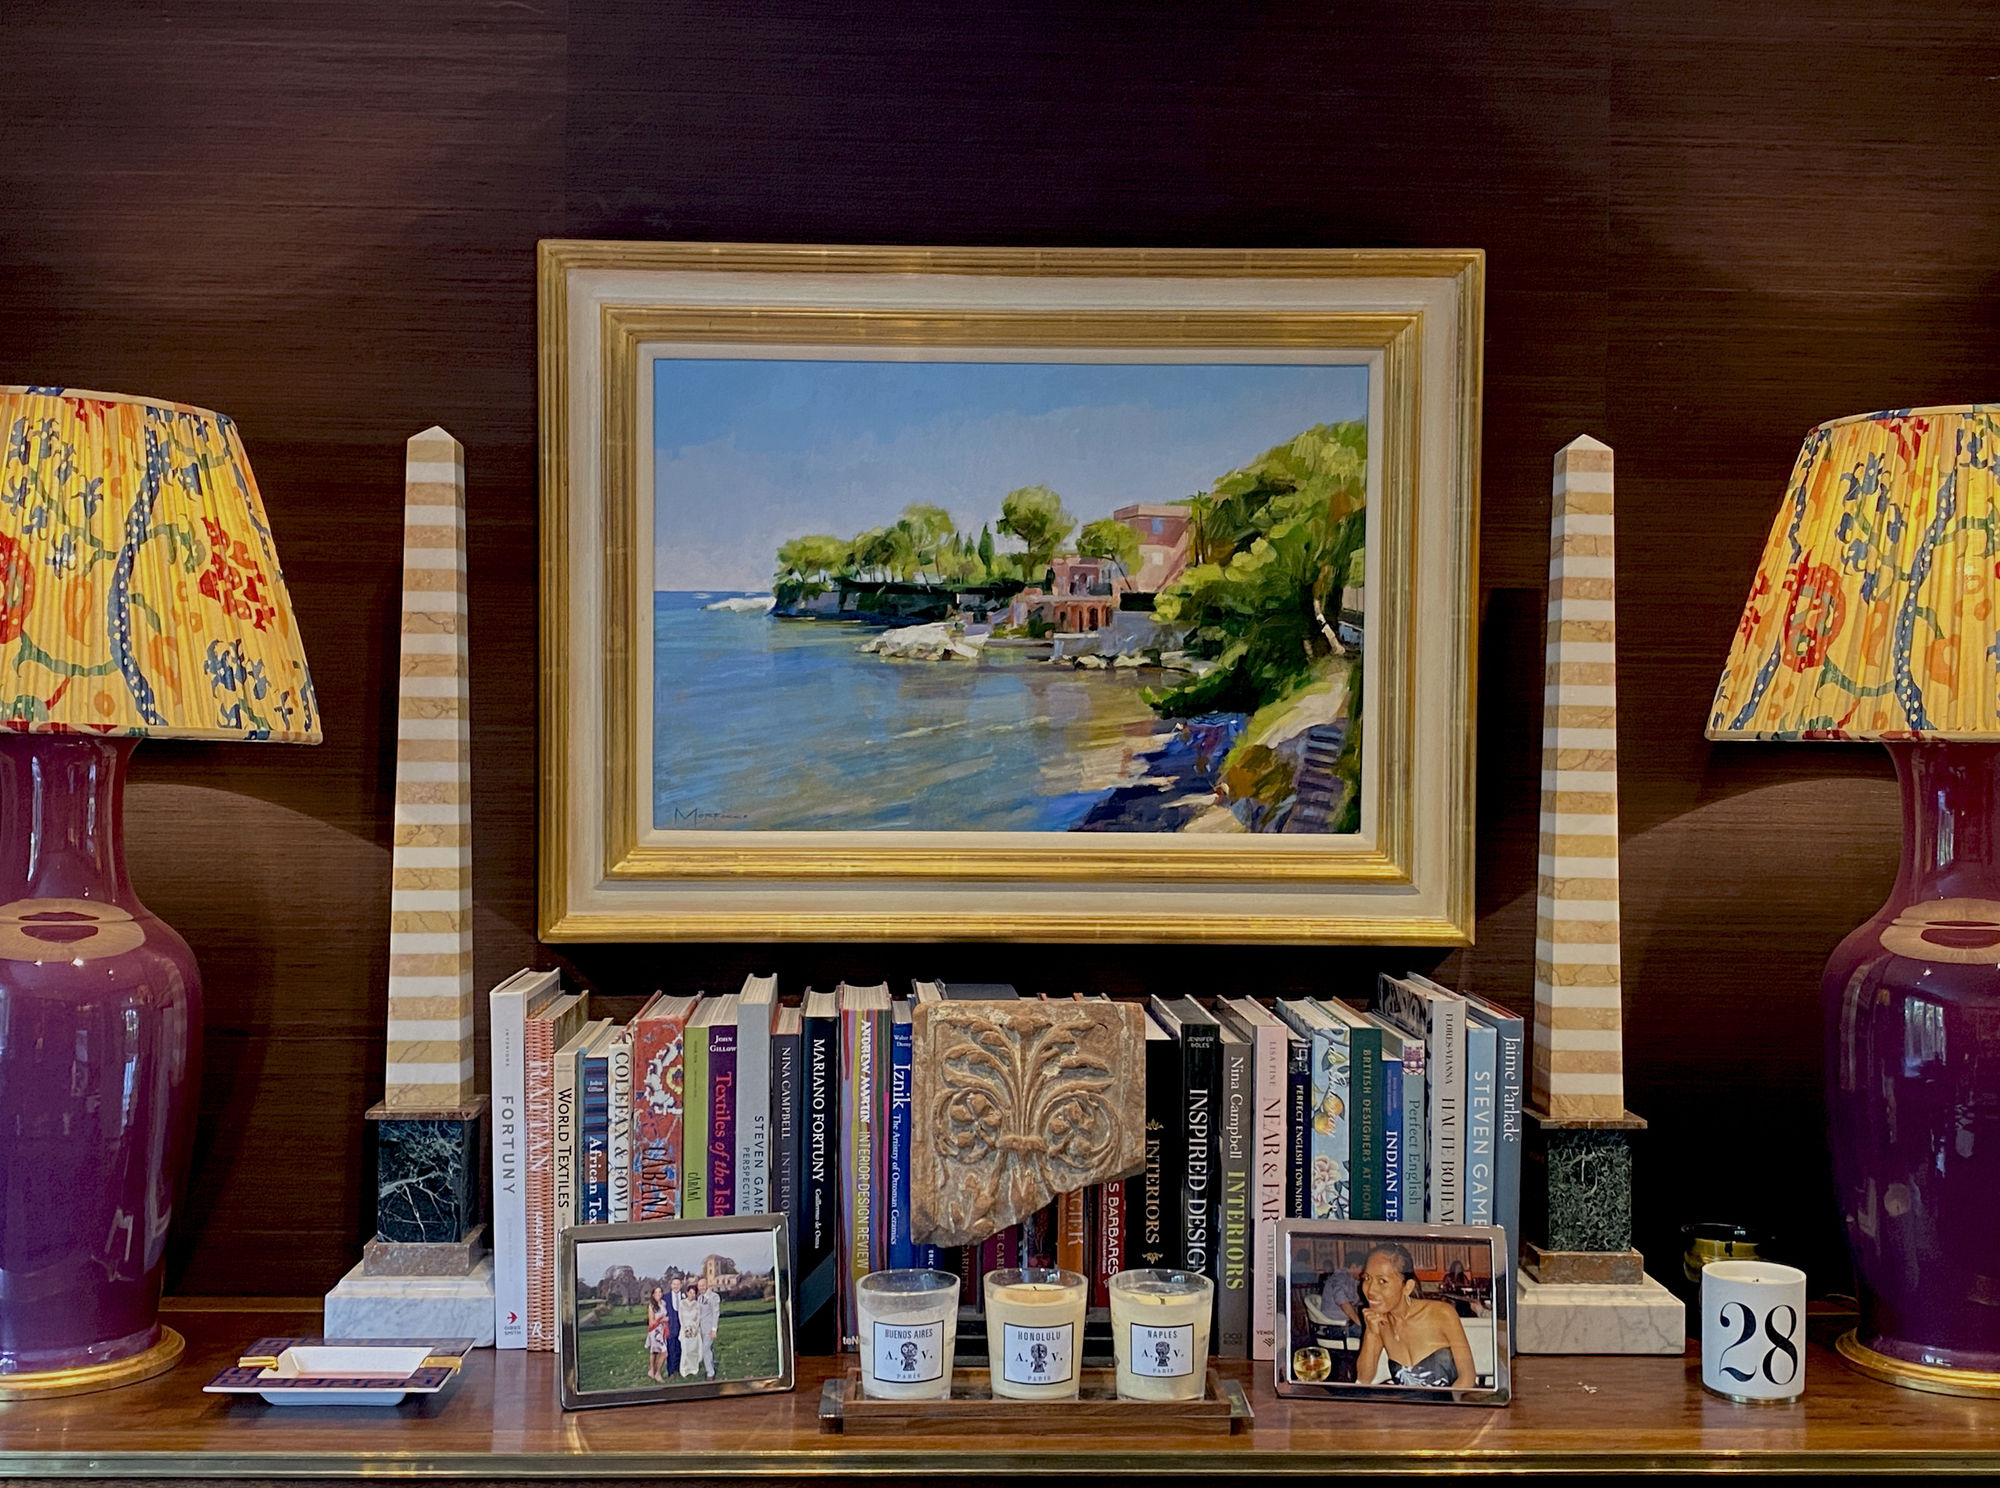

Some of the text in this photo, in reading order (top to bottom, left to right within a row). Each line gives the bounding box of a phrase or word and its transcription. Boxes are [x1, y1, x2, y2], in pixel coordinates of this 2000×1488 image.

[860, 1020, 872, 1123] ANDREW MARTIN
[1269, 1041, 1277, 1063] LISA
[1445, 1013, 1454, 1085] FLORES-VIANNA
[529, 1060, 551, 1172] RATTAN
[558, 1088, 572, 1142] WORLD
[614, 1052, 630, 1141] COLEFAX
[714, 1072, 732, 1138] Textiles
[781, 1047, 791, 1140] NINA CAMPBELL
[812, 1039, 825, 1183] MARIANO FORTUNY
[892, 1064, 911, 1109] Iznik
[1226, 1056, 1244, 1159] Nina Campbell
[1295, 1084, 1304, 1123] PERFECT
[1473, 1071, 1490, 1154] STEVEN
[1502, 1036, 1520, 1142] Jaime Parladé
[502, 1096, 516, 1194] FORTUNY
[754, 1116, 764, 1168] STEVEN
[892, 1114, 902, 1130] The
[1295, 1125, 1304, 1165] ENGLISH
[1362, 1049, 1371, 1218] BRITISH DESIGNERS AT HOME
[1405, 1100, 1422, 1205] Perfect English
[558, 1146, 572, 1208] TEXTILES
[588, 1137, 602, 1195] African
[614, 1150, 628, 1160] &
[641, 1148, 676, 1221] CABANA
[709, 1144, 730, 1164] of
[714, 1166, 730, 1185] the
[742, 1147, 751, 1212] PERSPECTIVE
[892, 1162, 901, 1171] of
[1187, 1089, 1208, 1275] INSPIRED DESIGN
[1262, 1098, 1281, 1222] NEAR & FAR
[1385, 1130, 1398, 1192] INDIAN
[1440, 1098, 1455, 1222] HAUTE BOHEM
[687, 1172, 702, 1202] CABANA
[856, 1131, 870, 1269] INTERIOR DESIGN REVIEW
[891, 1172, 901, 1207] Ottoman
[1145, 1139, 1160, 1244] INTERIORS
[890, 1209, 900, 1245] Ceramics
[1107, 1197, 1119, 1275] BARBARES
[1225, 1171, 1246, 1290] INTERIORS
[1266, 1234, 1275, 1285] INTERIORS
[885, 1328, 934, 1340] BUENOS AIRES
[885, 1350, 933, 1361] A. V.
[1015, 1352, 1063, 1362] A. V.
[1017, 1330, 1061, 1341] HONOLULU
[1141, 1348, 1184, 1358] A. V.
[1147, 1330, 1178, 1339] NAPLES
[1719, 1301, 1798, 1386] 28
